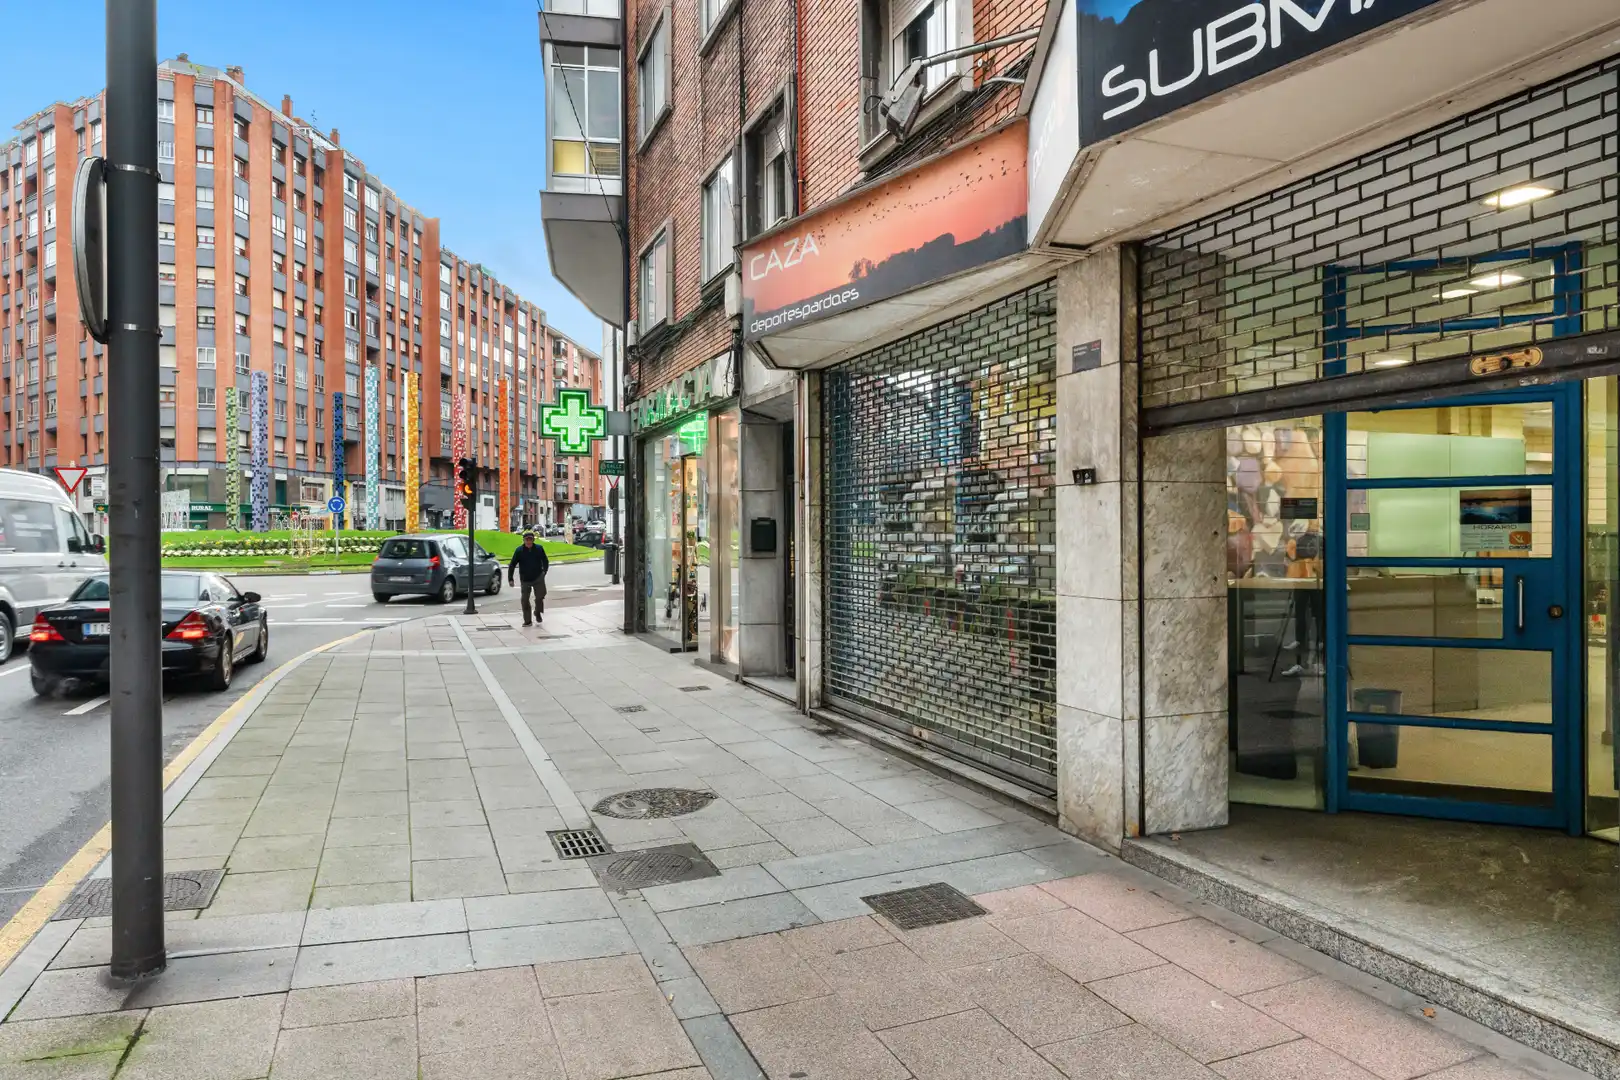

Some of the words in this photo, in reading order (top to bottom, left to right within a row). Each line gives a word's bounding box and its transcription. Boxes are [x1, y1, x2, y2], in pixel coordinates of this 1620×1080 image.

[1101, 0, 1375, 120] SUBM
[750, 232, 820, 281] CAZA
[750, 287, 860, 333] deportespardo.es
[630, 358, 714, 435] FARMACIA
